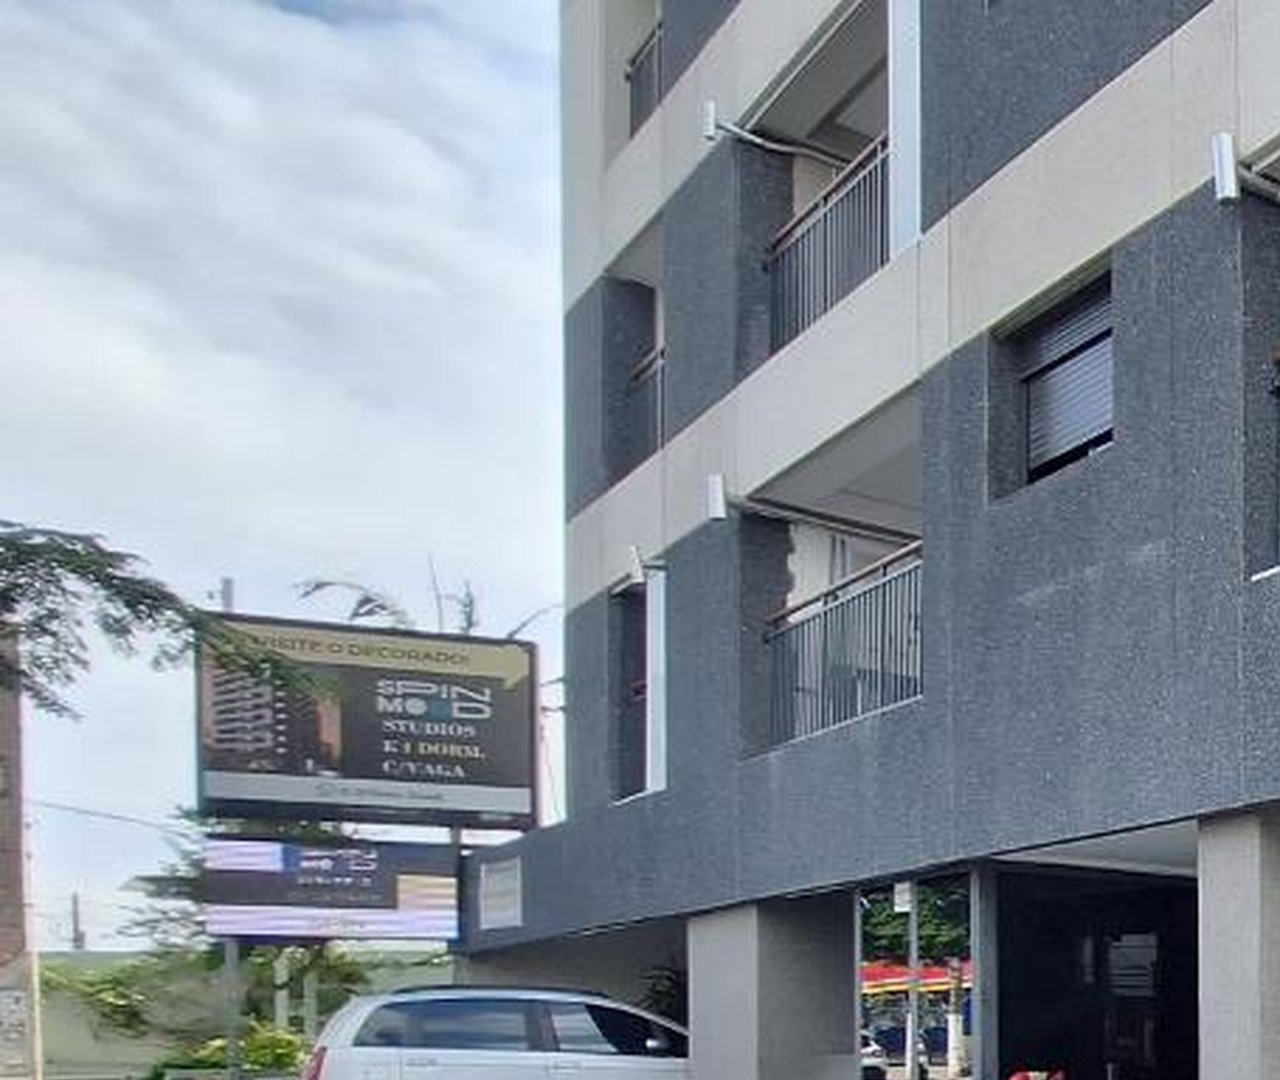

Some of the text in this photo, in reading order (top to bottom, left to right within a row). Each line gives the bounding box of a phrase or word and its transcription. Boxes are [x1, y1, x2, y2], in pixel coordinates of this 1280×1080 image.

[327, 641, 343, 653] O
[377, 680, 491, 701] SPIN
[382, 720, 476, 738] STUDIOS
[383, 740, 399, 753] E
[382, 759, 466, 778] C/VAGA
